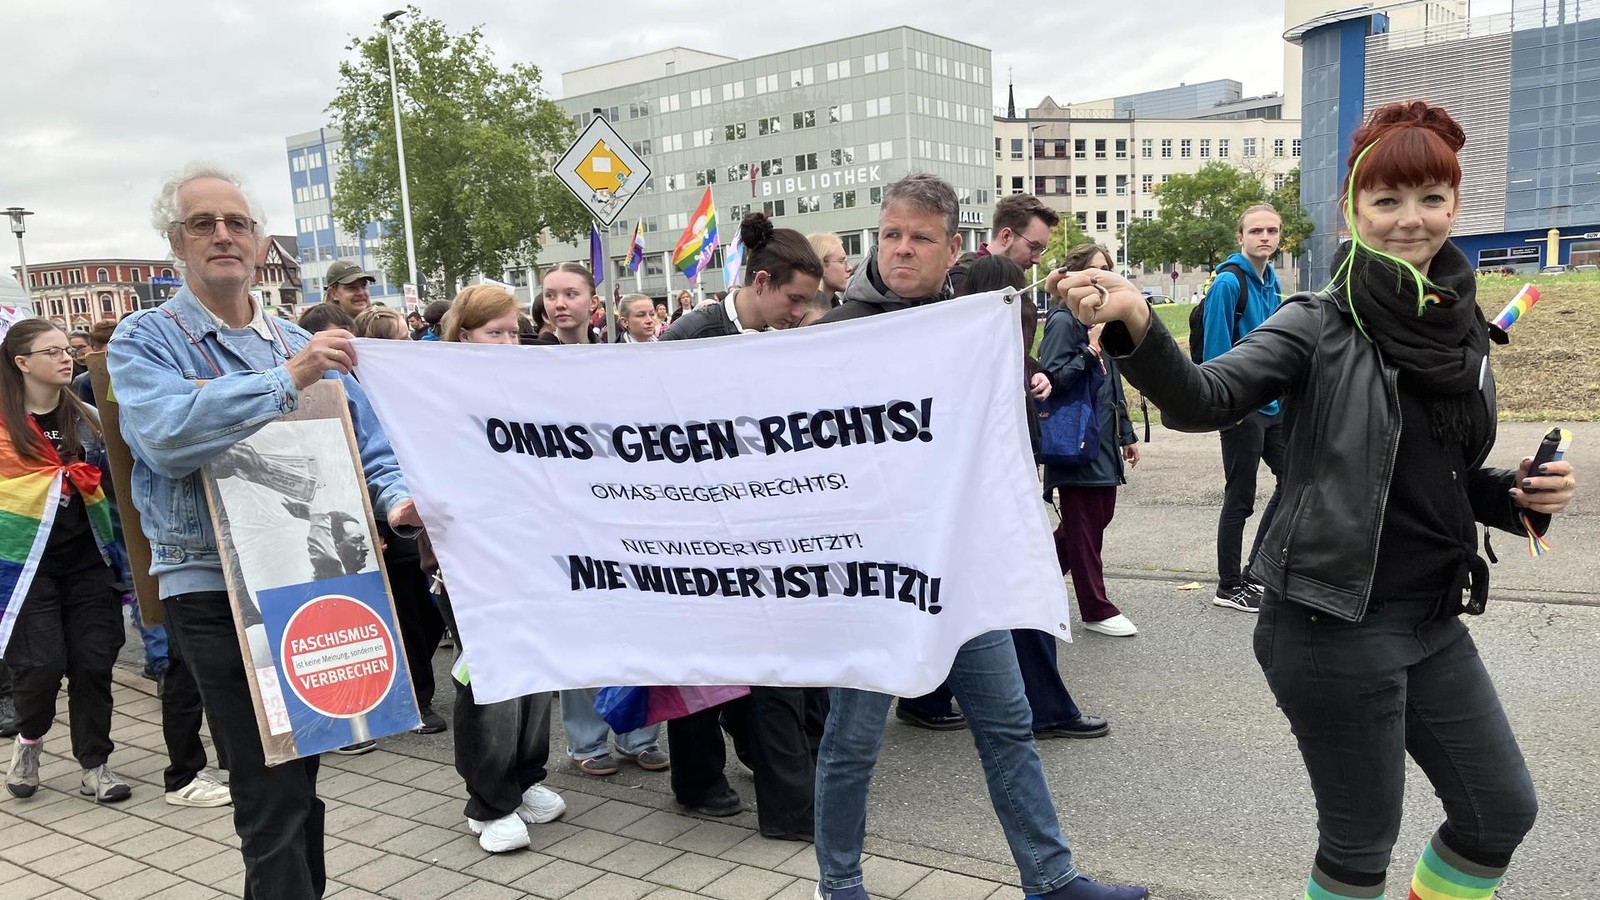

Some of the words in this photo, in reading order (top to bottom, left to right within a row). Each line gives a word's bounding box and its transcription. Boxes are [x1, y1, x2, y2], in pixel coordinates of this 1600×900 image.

[762, 165, 881, 196] BIBLIOTHEK
[486, 417, 593, 460] OMAS
[612, 420, 739, 463] GEGEN
[759, 397, 933, 456] RECHTS!
[591, 484, 657, 501] OMAS
[663, 484, 741, 502] GEGEN
[748, 473, 849, 499] RECHTS!
[621, 538, 660, 555] NIE
[659, 540, 750, 557] WIEDER
[751, 539, 783, 555] IST
[791, 533, 864, 554] JETZT!
[568, 555, 627, 591] NIE
[629, 564, 766, 598] WIEDER
[772, 564, 830, 598] IST
[843, 561, 942, 615] JETZT!
[290, 623, 379, 654] FASCHISMUS
[296, 661, 304, 669] ist
[304, 657, 321, 668] keine
[322, 651, 350, 663] Meinung,
[350, 645, 374, 658] sondern
[374, 643, 384, 652] ein
[300, 658, 389, 690] VERBRECHEN
